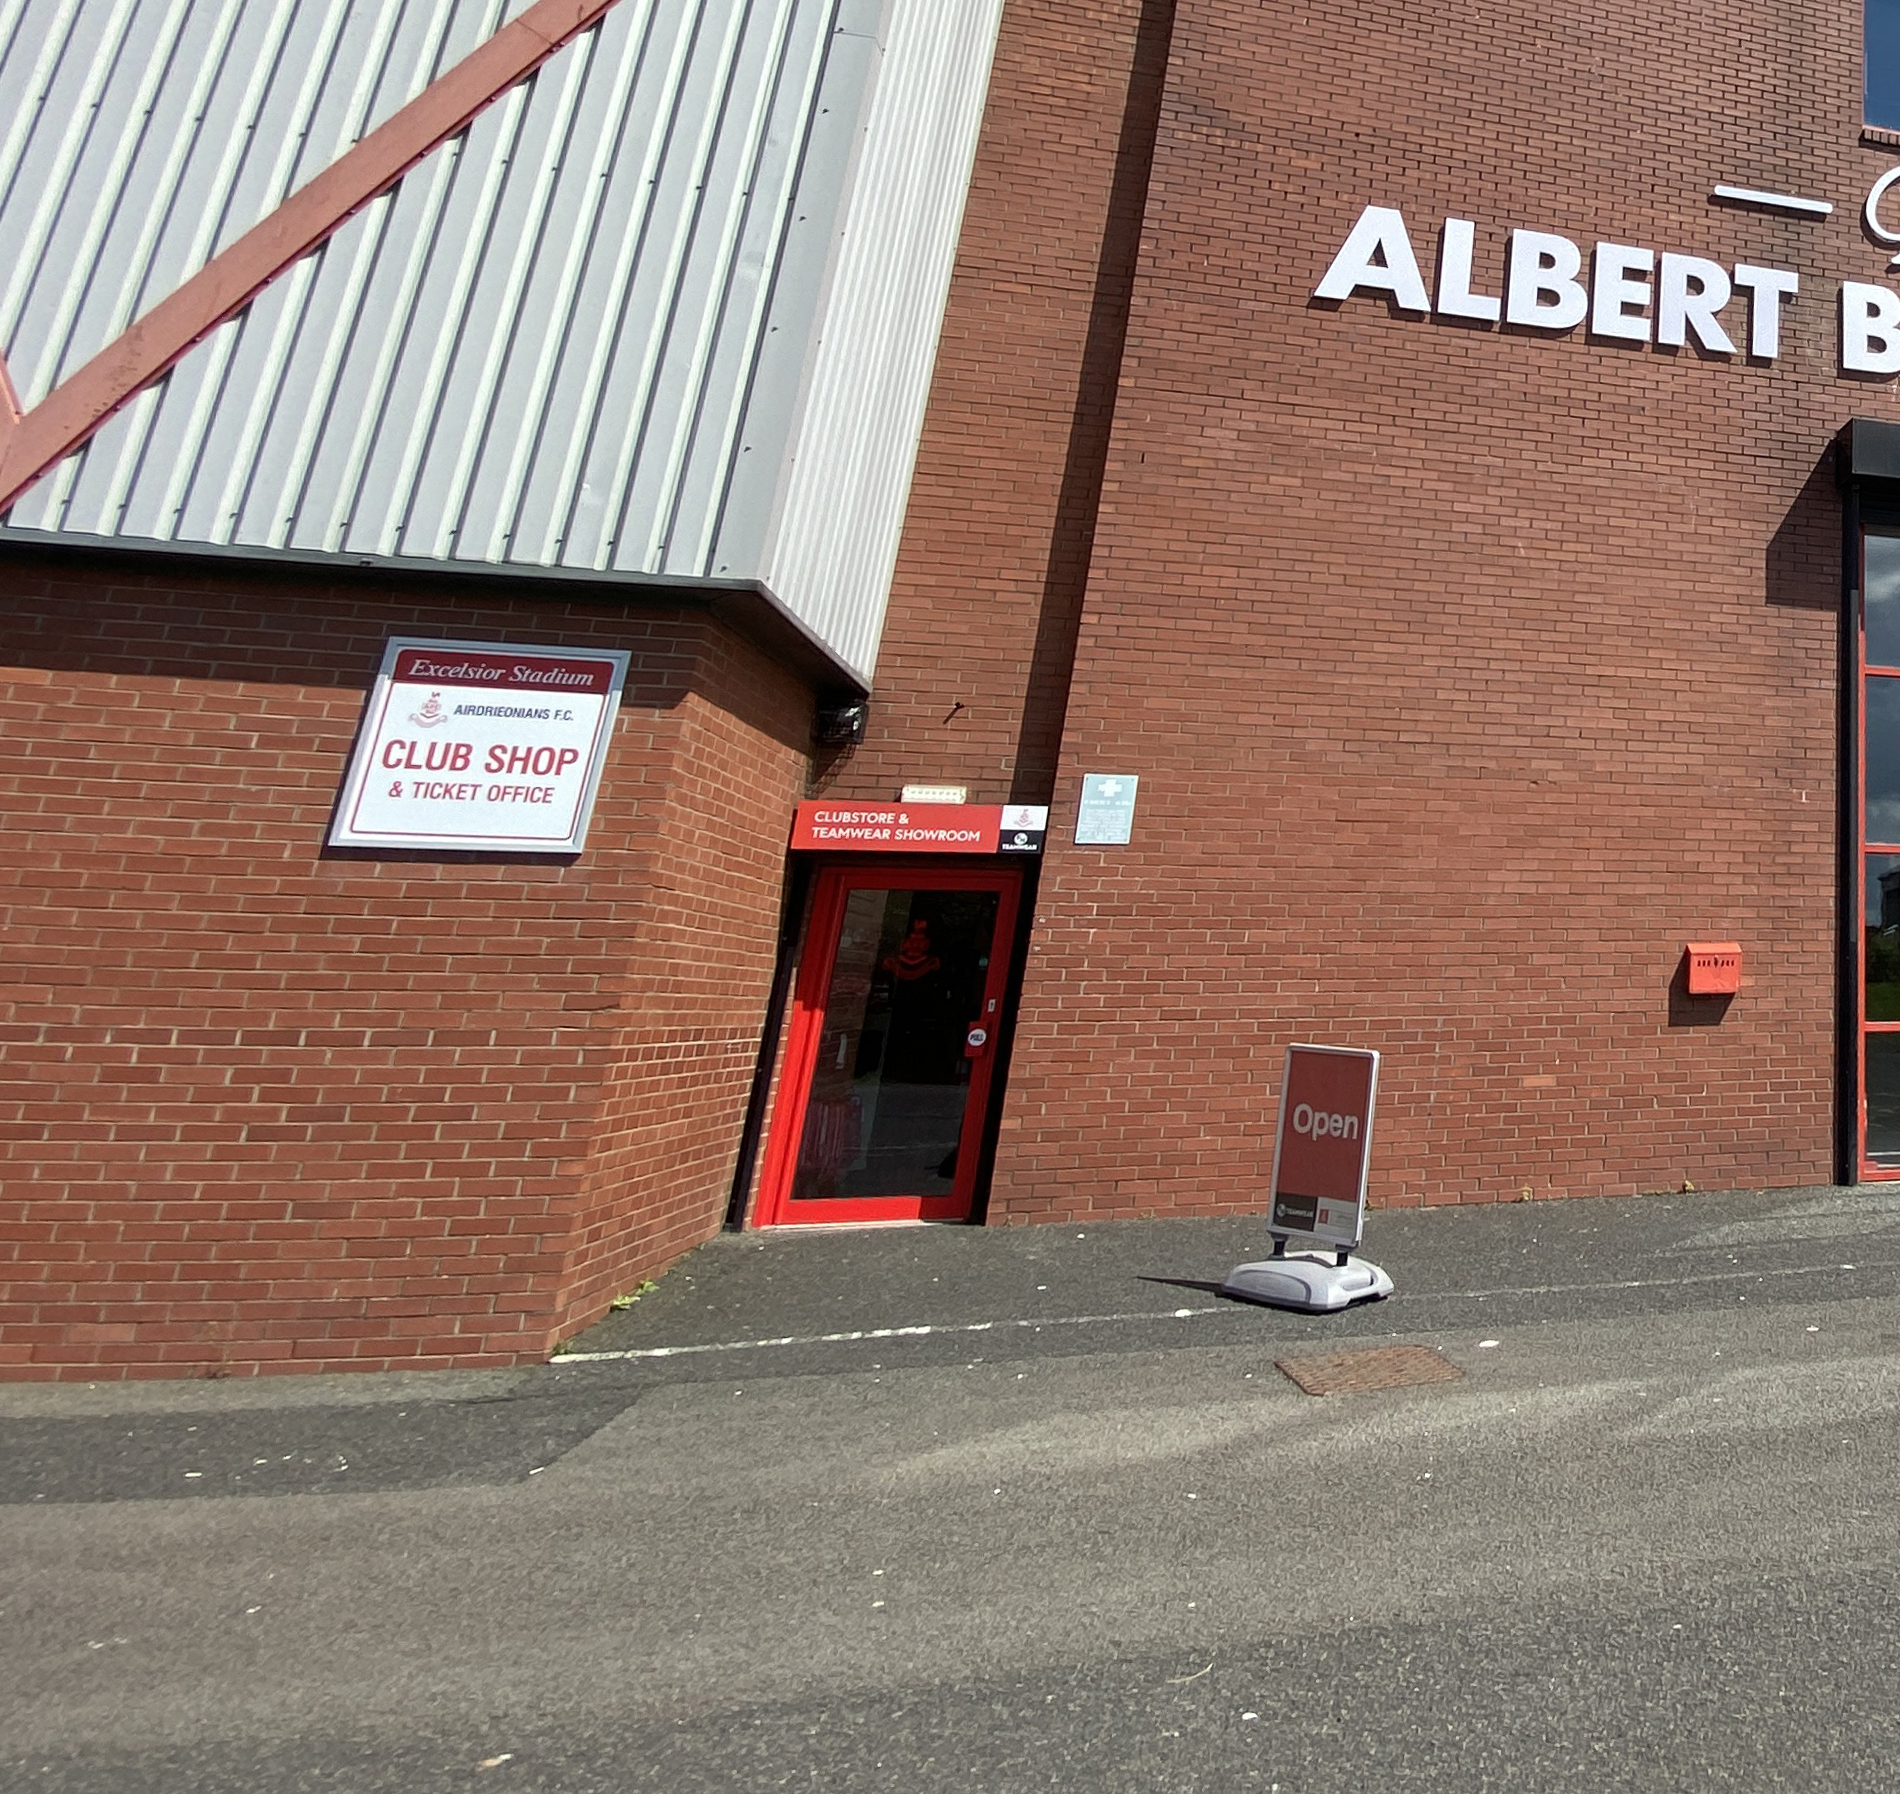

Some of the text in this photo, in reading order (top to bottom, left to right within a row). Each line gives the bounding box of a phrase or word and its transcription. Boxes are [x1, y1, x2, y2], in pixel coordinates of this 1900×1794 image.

[1313, 204, 1799, 359] ALBERT
[408, 659, 594, 686] Excelsior Stadium
[453, 704, 550, 720] AIRDRIEONIANS
[553, 709, 574, 721] F.C.
[381, 739, 580, 776] CLUB SHOP
[388, 781, 556, 804] & TICKET OFFICE
[814, 811, 909, 824] CLUBSTORE &
[811, 826, 981, 842] TEAMWEAR SHOWROOM
[1292, 1103, 1359, 1141] Open
